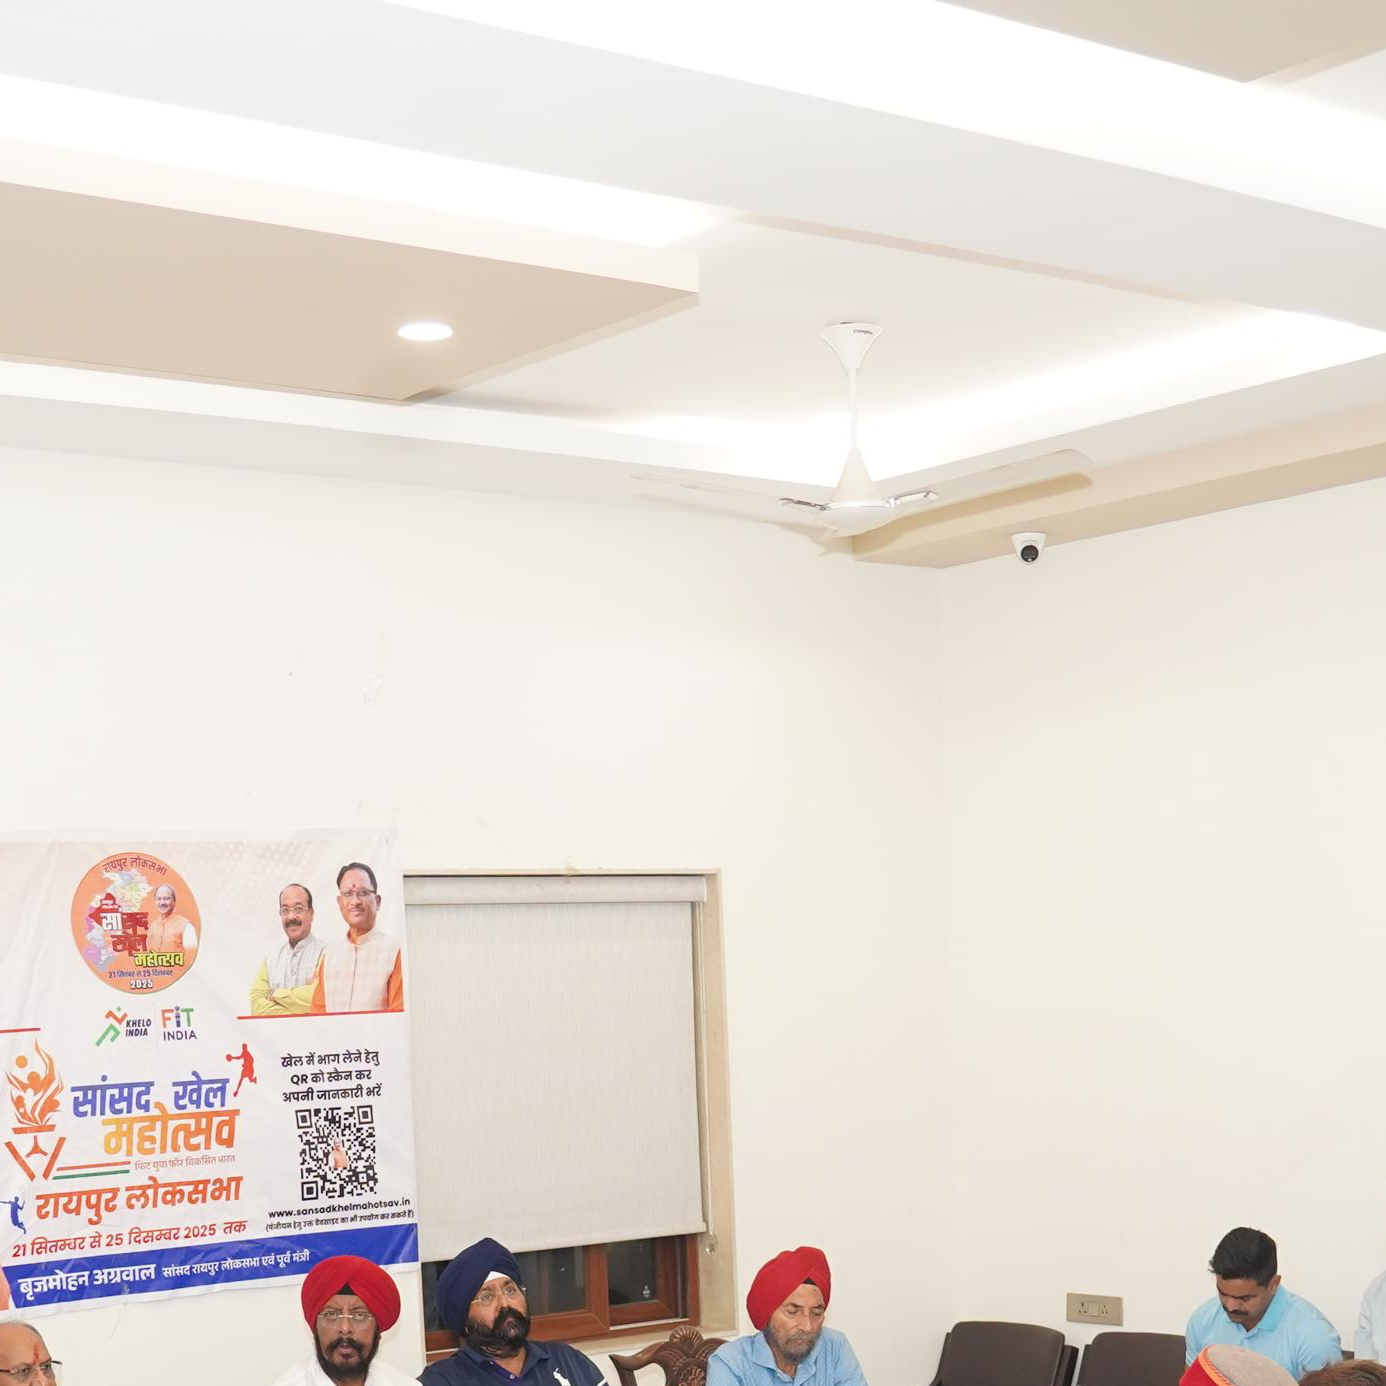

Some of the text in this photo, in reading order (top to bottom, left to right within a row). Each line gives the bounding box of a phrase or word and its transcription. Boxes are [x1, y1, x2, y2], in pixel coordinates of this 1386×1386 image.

[134, 950, 184, 967] महोत्सव
[130, 980, 153, 989] 2025
[126, 1018, 152, 1027] KHELO
[125, 1028, 148, 1037] INDIA
[163, 1030, 197, 1041] INDIA
[281, 1048, 380, 1067] खेल में भाग लेने हेतु
[290, 1073, 308, 1086] QR
[311, 1069, 325, 1083] को
[355, 1069, 372, 1080] कर
[71, 1070, 230, 1117] सांसद खेल
[282, 1083, 383, 1102] अपनी जानकारी भरें
[102, 1101, 240, 1156] महोत्सव
[135, 1160, 151, 1170] फिट
[185, 1155, 217, 1166] विकसित
[218, 1154, 236, 1163] भारत
[35, 1175, 243, 1225] रायपुर लोकसभा
[268, 1197, 411, 1218] www.sansadkhelmahotsav.in
[12, 1220, 248, 1257] 21 सितम्बर से 25 दिसम्बर 2025 तक
[18, 1249, 310, 1300] बृजमोहन अग्रवाल सांसद रायपुर लोकसभा एवं पूर्व मंत्री
